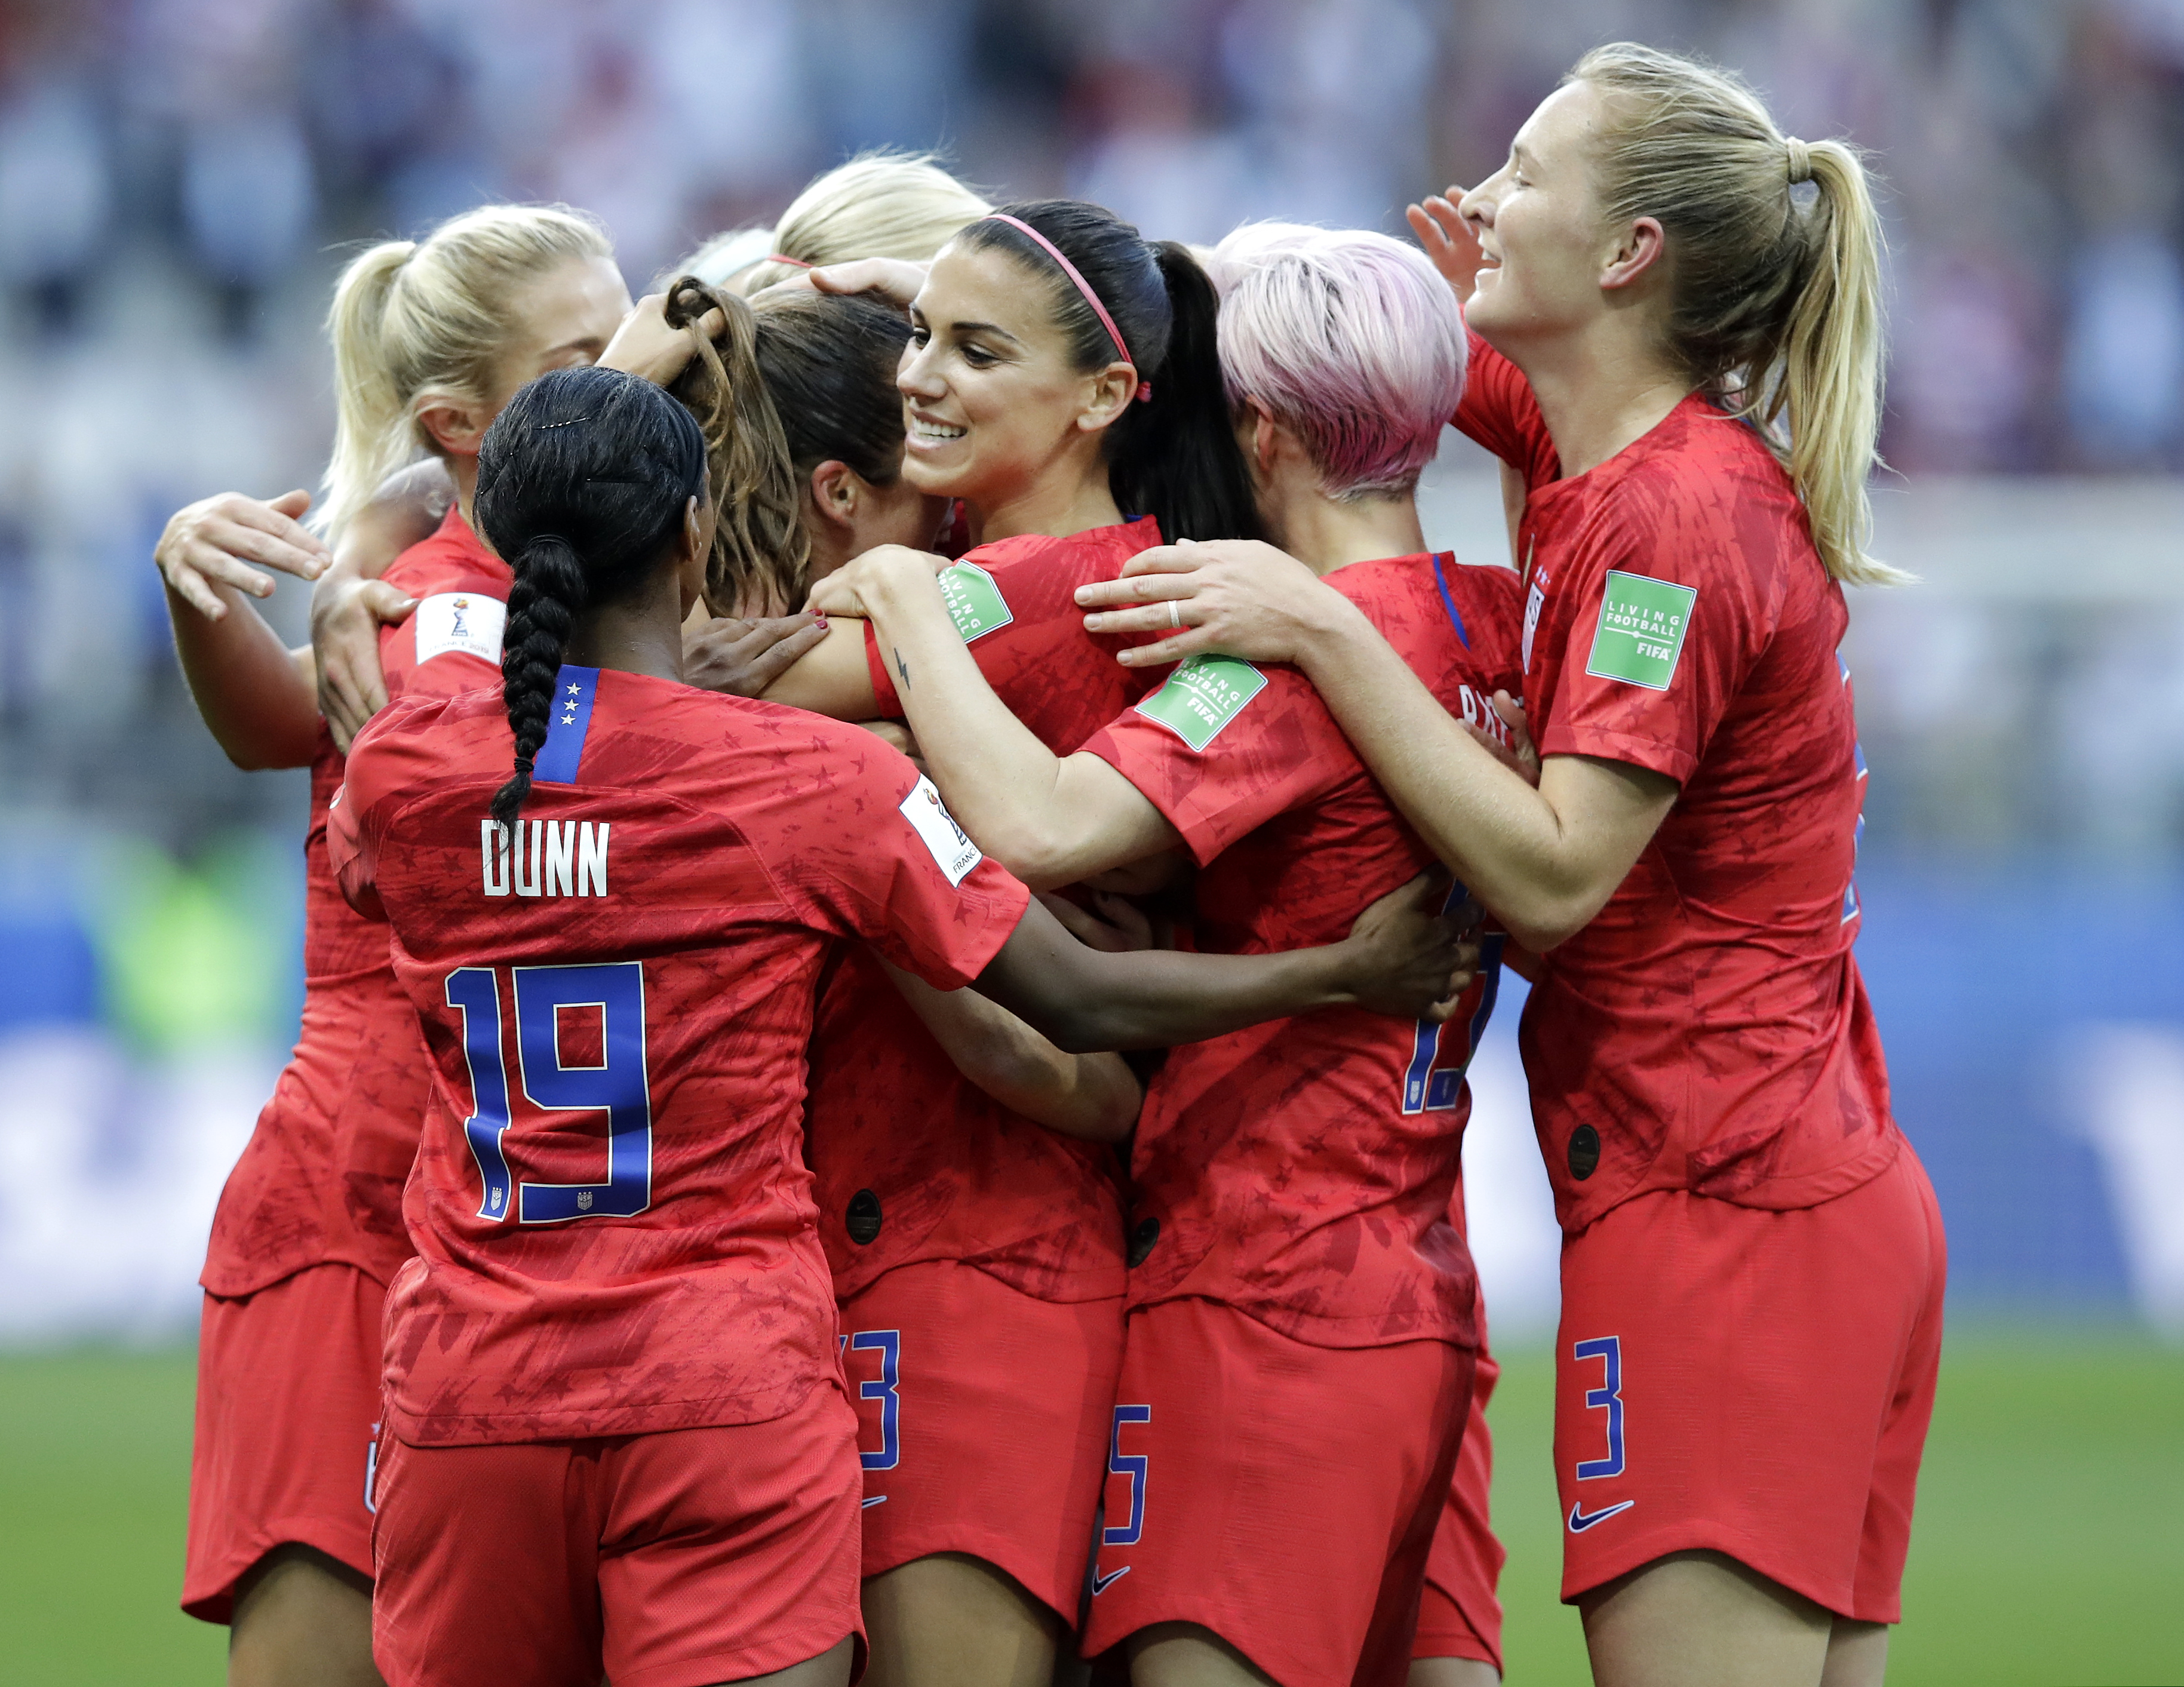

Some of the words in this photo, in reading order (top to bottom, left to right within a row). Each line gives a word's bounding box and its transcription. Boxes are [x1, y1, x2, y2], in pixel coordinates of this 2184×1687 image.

[937, 573, 969, 634] FOOTBALL
[945, 566, 981, 629] LIVING
[1606, 613, 1675, 637] FOOTBALL
[1608, 601, 1680, 626] LIVING
[1636, 642, 1671, 661] FIFA
[1175, 668, 1231, 709] FOOTBALL
[1187, 696, 1217, 726] FIFA
[480, 818, 610, 898] DUNN
[444, 960, 653, 1224] 19
[839, 1329, 900, 1470] 3
[1574, 1335, 1625, 1482] 3
[1104, 1405, 1151, 1545] 5
